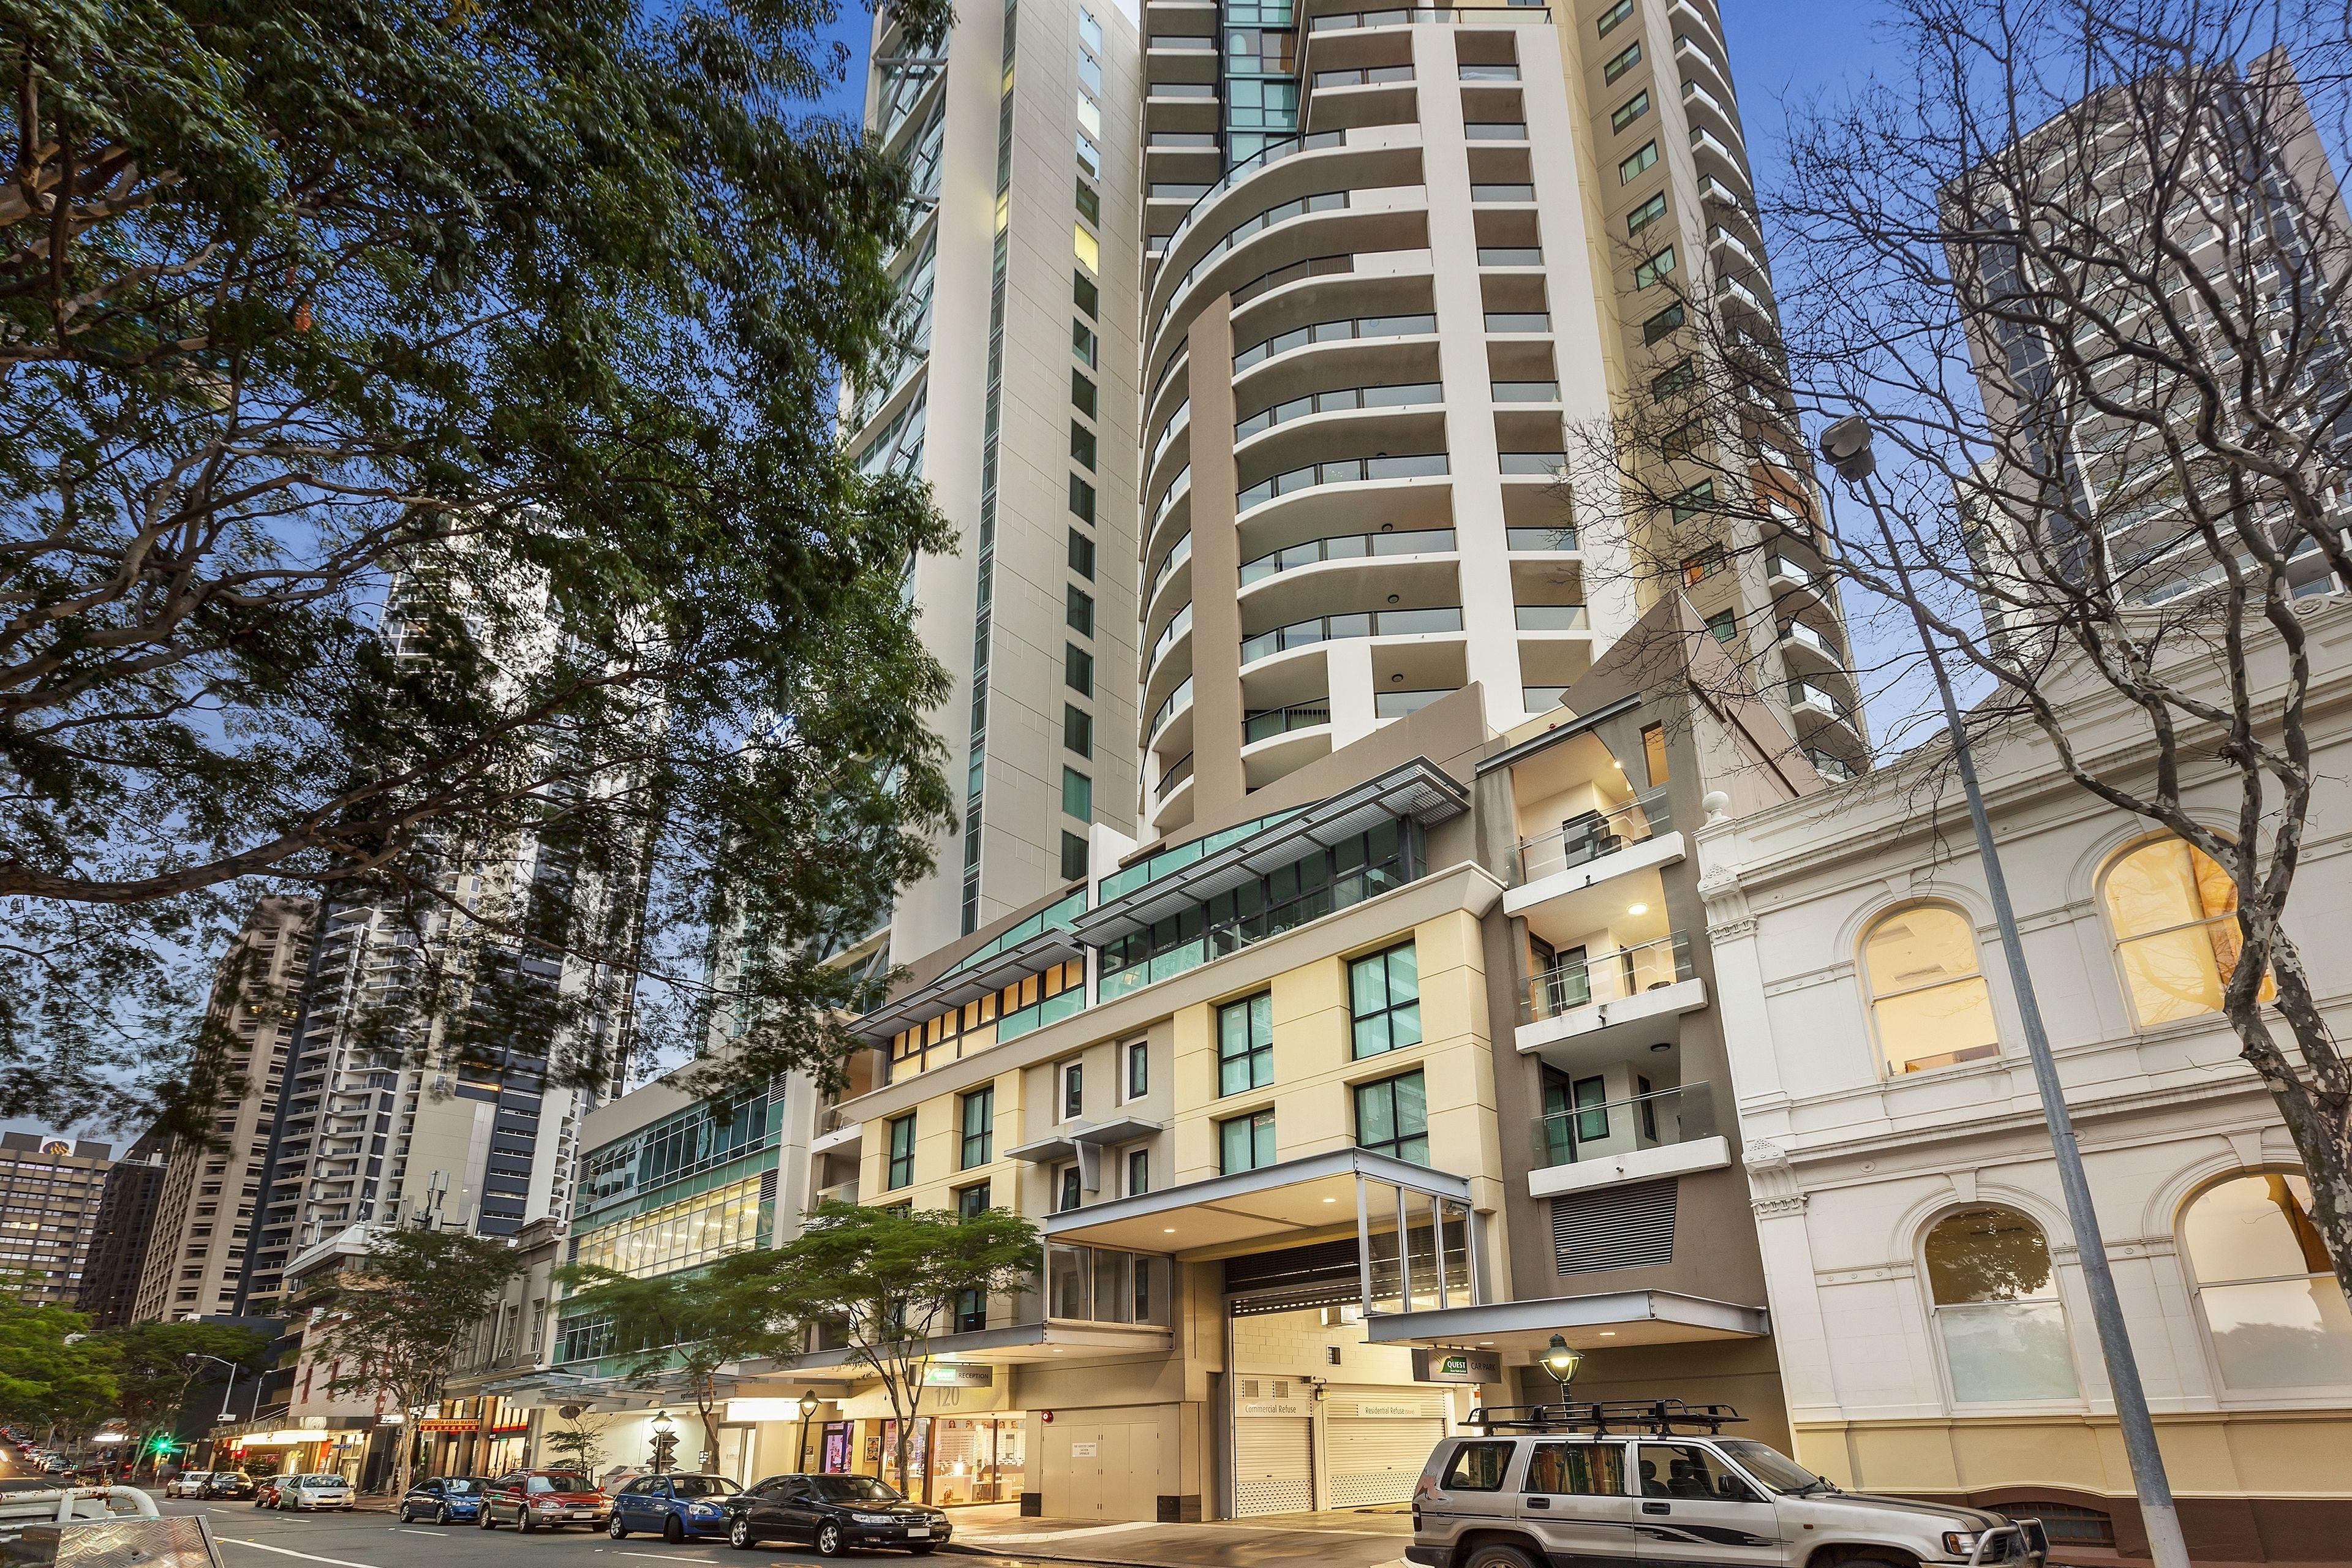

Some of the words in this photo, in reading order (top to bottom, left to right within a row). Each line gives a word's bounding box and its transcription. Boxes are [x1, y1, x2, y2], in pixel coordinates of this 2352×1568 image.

[628, 1218, 687, 1261] SALE
[936, 1387, 960, 1407] 120
[1245, 1404, 1277, 1413] Commercial
[1278, 1404, 1297, 1413] Refuse
